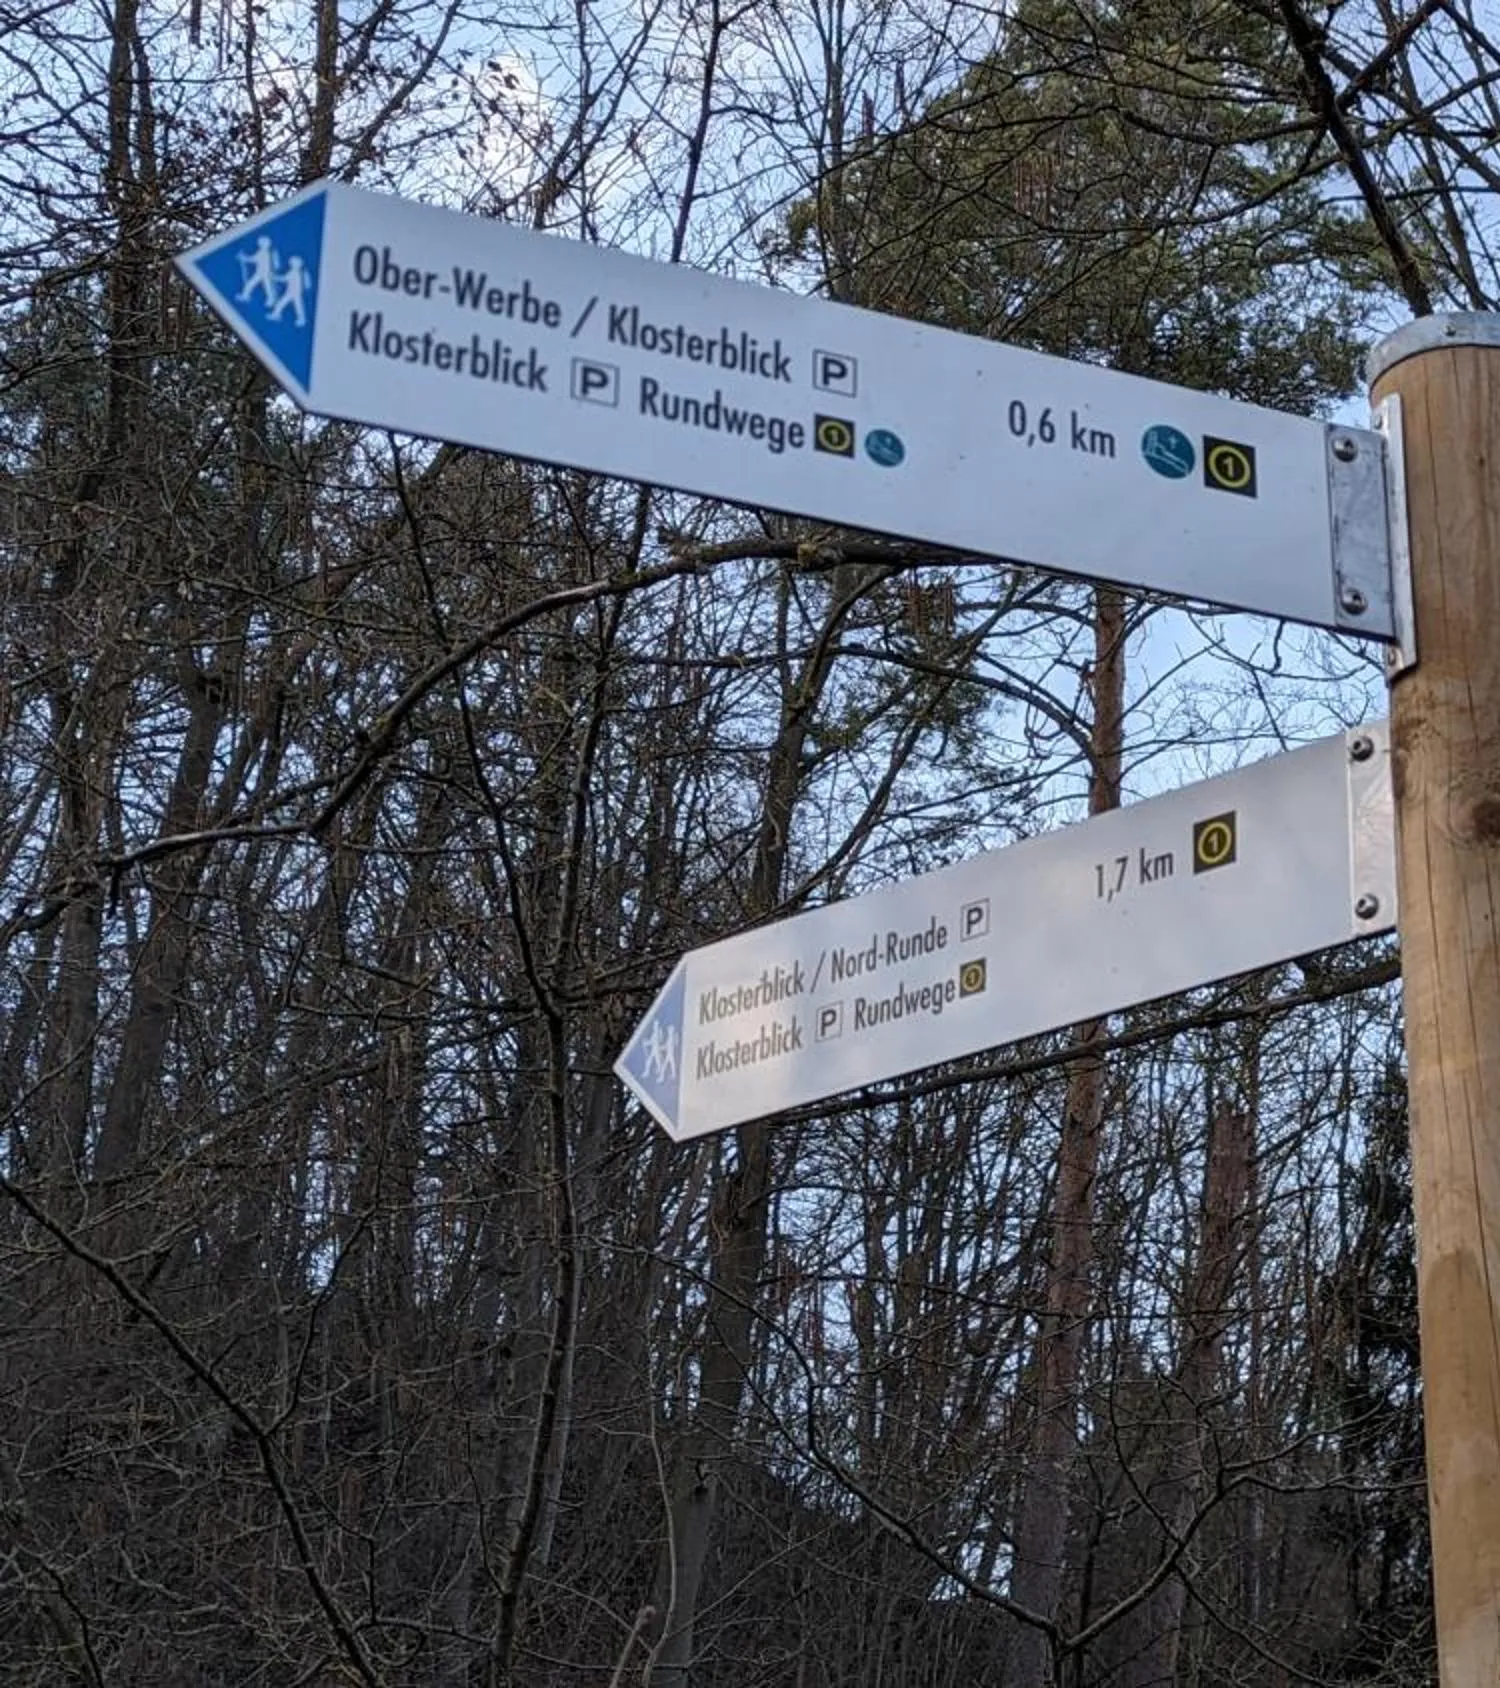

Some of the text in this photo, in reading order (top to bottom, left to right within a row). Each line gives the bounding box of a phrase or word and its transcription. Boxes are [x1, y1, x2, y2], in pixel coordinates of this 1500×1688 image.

[353, 244, 848, 386] Ober-Werbe / Klosterblick P
[347, 310, 549, 393] Klosterblick
[580, 364, 609, 397] P
[639, 375, 806, 455] Rundwege
[1008, 399, 1056, 448] 0,6
[1070, 409, 1116, 459] km
[1095, 854, 1129, 904] 1,7
[1139, 846, 1174, 885] km
[699, 906, 984, 1025] Klosterblick / Nord-Runde P
[696, 1015, 803, 1081] Klosterblick
[820, 1010, 837, 1037] P
[853, 978, 957, 1032] Rundwege
